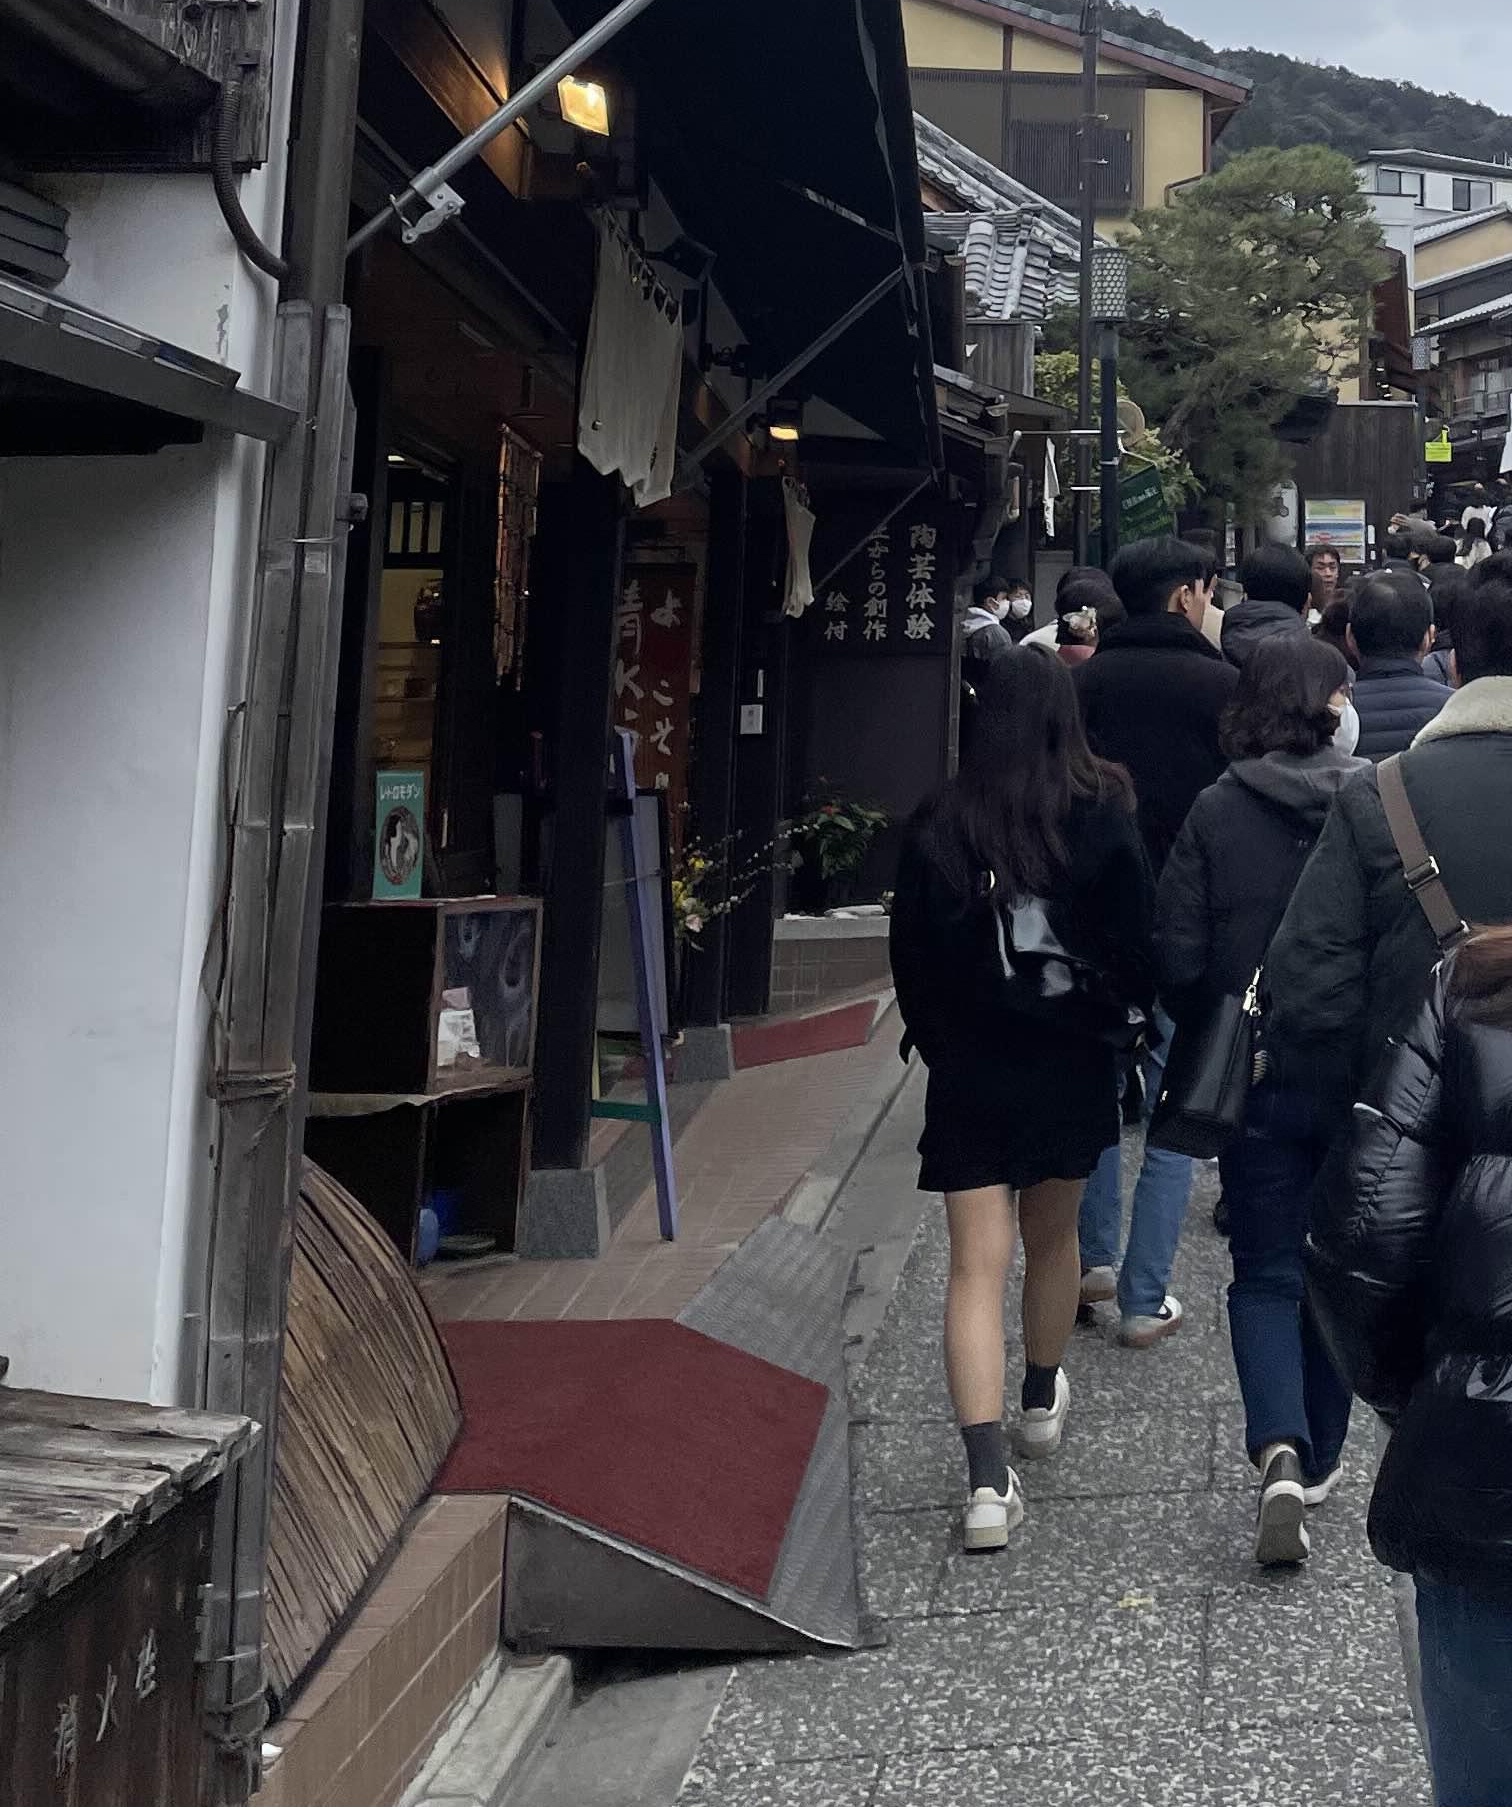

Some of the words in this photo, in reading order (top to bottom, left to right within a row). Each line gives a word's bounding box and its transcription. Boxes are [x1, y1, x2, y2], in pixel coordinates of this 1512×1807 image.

[824, 591, 849, 641] 絵付
[904, 523, 936, 640] 陶芸体験
